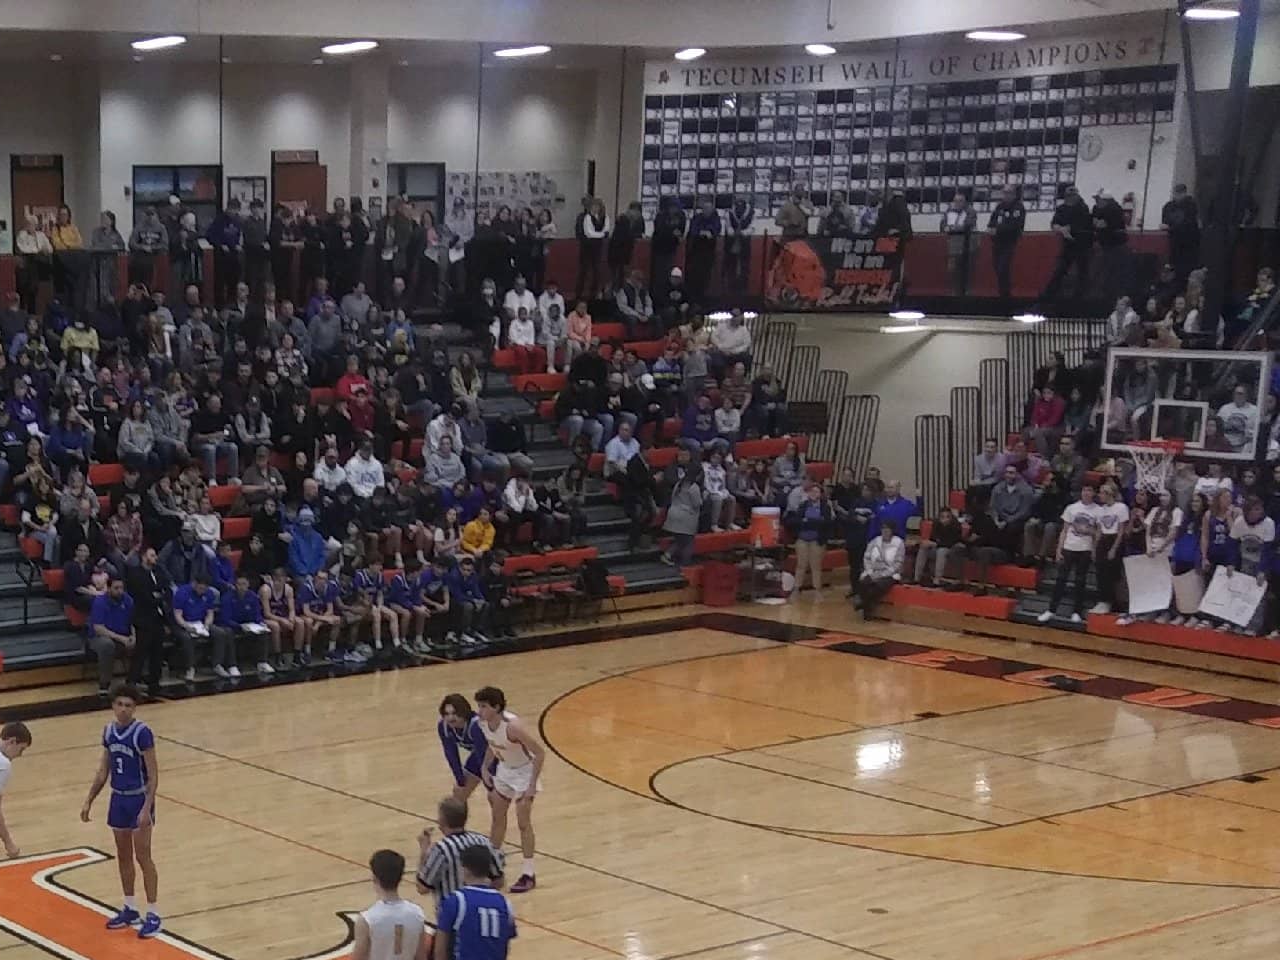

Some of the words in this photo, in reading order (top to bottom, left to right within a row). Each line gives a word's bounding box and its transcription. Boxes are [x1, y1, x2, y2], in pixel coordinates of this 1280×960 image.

[680, 64, 825, 87] TECUMSEH
[841, 60, 913, 82] WALL
[929, 55, 961, 76] OF
[972, 40, 1128, 73] CHAMPIONS
[794, 632, 1280, 728] TECU
[478, 906, 499, 938] 11
